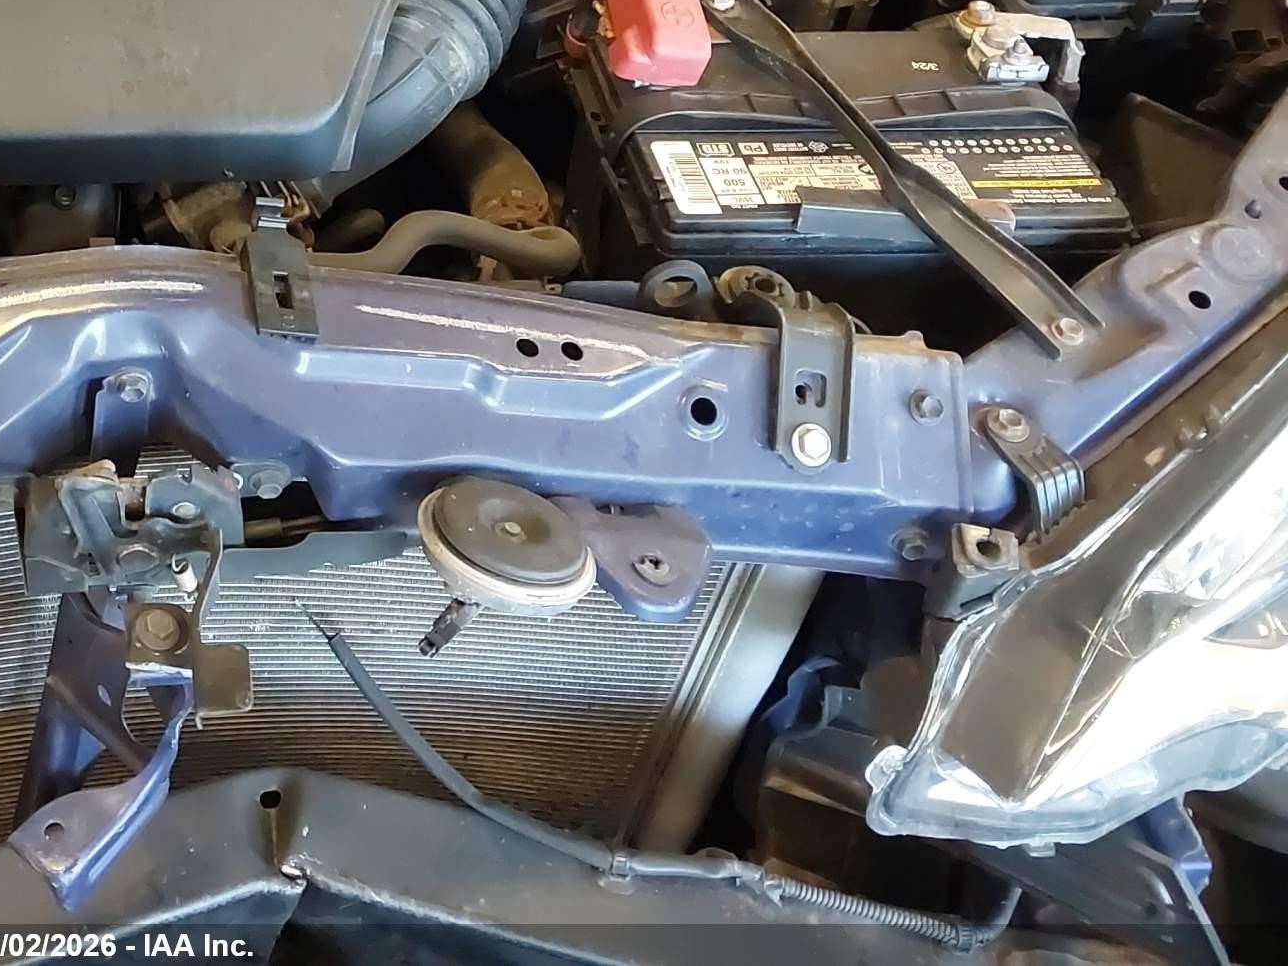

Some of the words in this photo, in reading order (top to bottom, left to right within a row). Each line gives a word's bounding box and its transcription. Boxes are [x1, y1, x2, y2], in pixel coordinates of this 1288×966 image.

[743, 143, 763, 153] Pb
[712, 167, 732, 175] RC
[723, 178, 746, 187] 500
